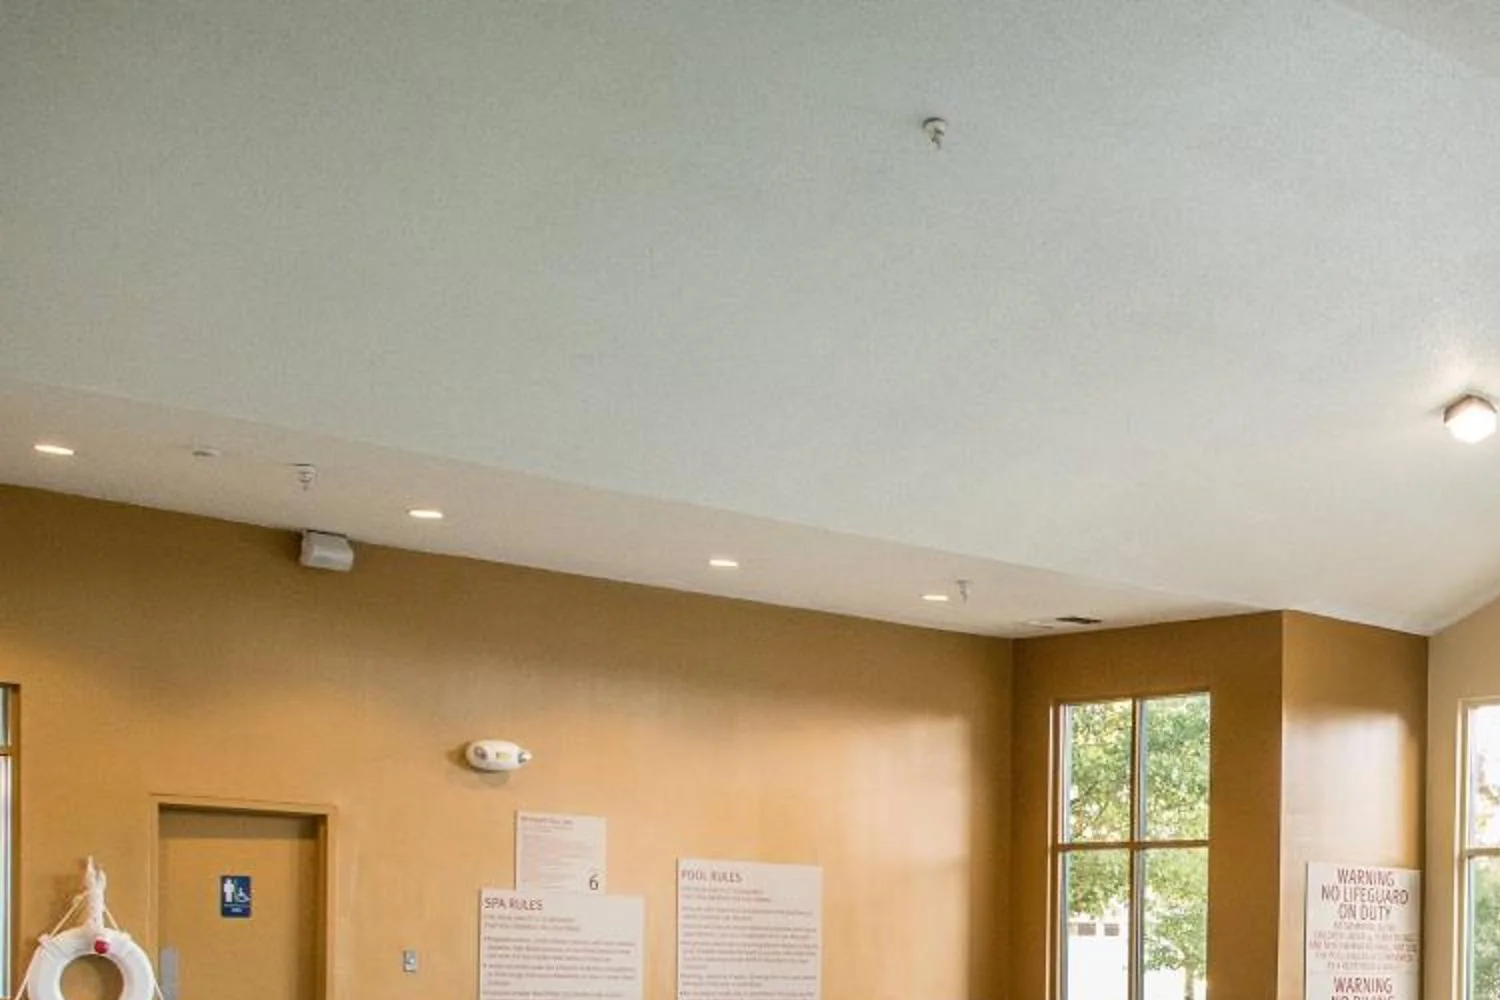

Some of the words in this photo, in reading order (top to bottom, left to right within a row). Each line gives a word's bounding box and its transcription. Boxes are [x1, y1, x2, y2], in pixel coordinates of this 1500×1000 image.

[589, 874, 599, 891] 6
[681, 870, 707, 881] POOL
[711, 871, 743, 883] RULES
[1337, 868, 1395, 887] WARNING
[1321, 883, 1340, 902] NO
[1343, 886, 1409, 905] LIFEGUARD
[484, 897, 507, 909] SPA
[509, 898, 543, 911] RULES
[1338, 903, 1357, 920] ON
[1360, 904, 1391, 921] DUTY
[1333, 976, 1393, 994] WARNING
